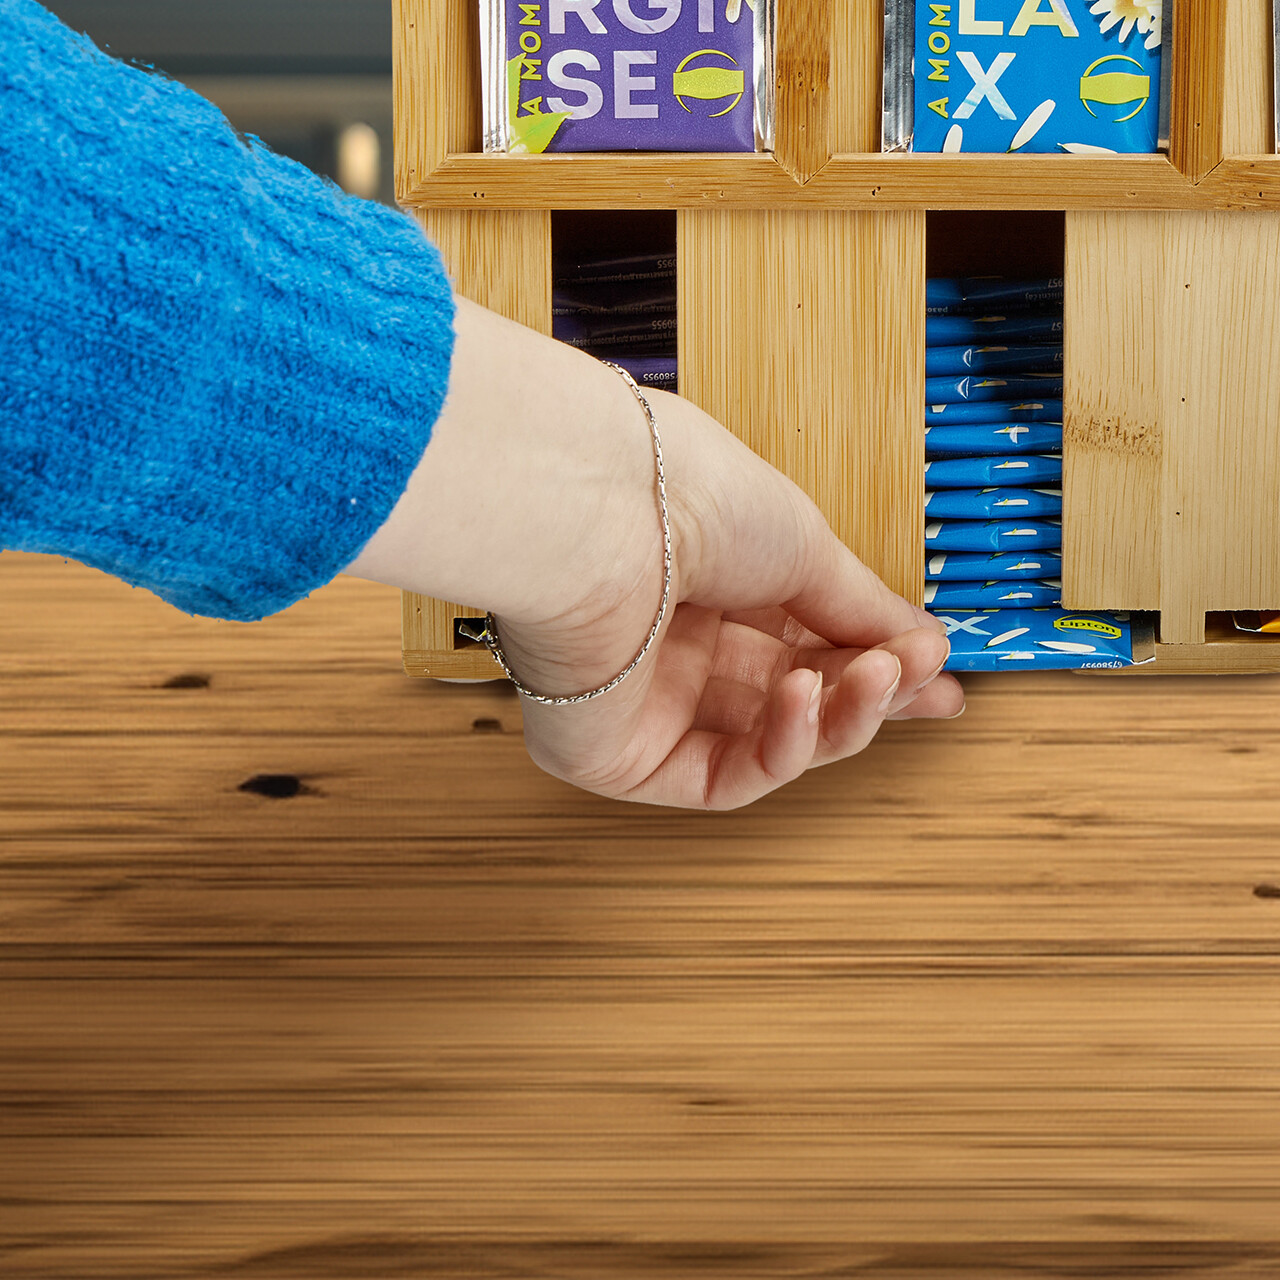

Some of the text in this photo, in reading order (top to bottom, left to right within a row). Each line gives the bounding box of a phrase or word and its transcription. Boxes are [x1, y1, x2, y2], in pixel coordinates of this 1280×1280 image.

[546, 49, 659, 120] SE
[952, 51, 1017, 121] X
[521, 95, 543, 119] A
[927, 96, 949, 119] A
[643, 372, 676, 382] 580955
[1060, 621, 1116, 633] Lipton
